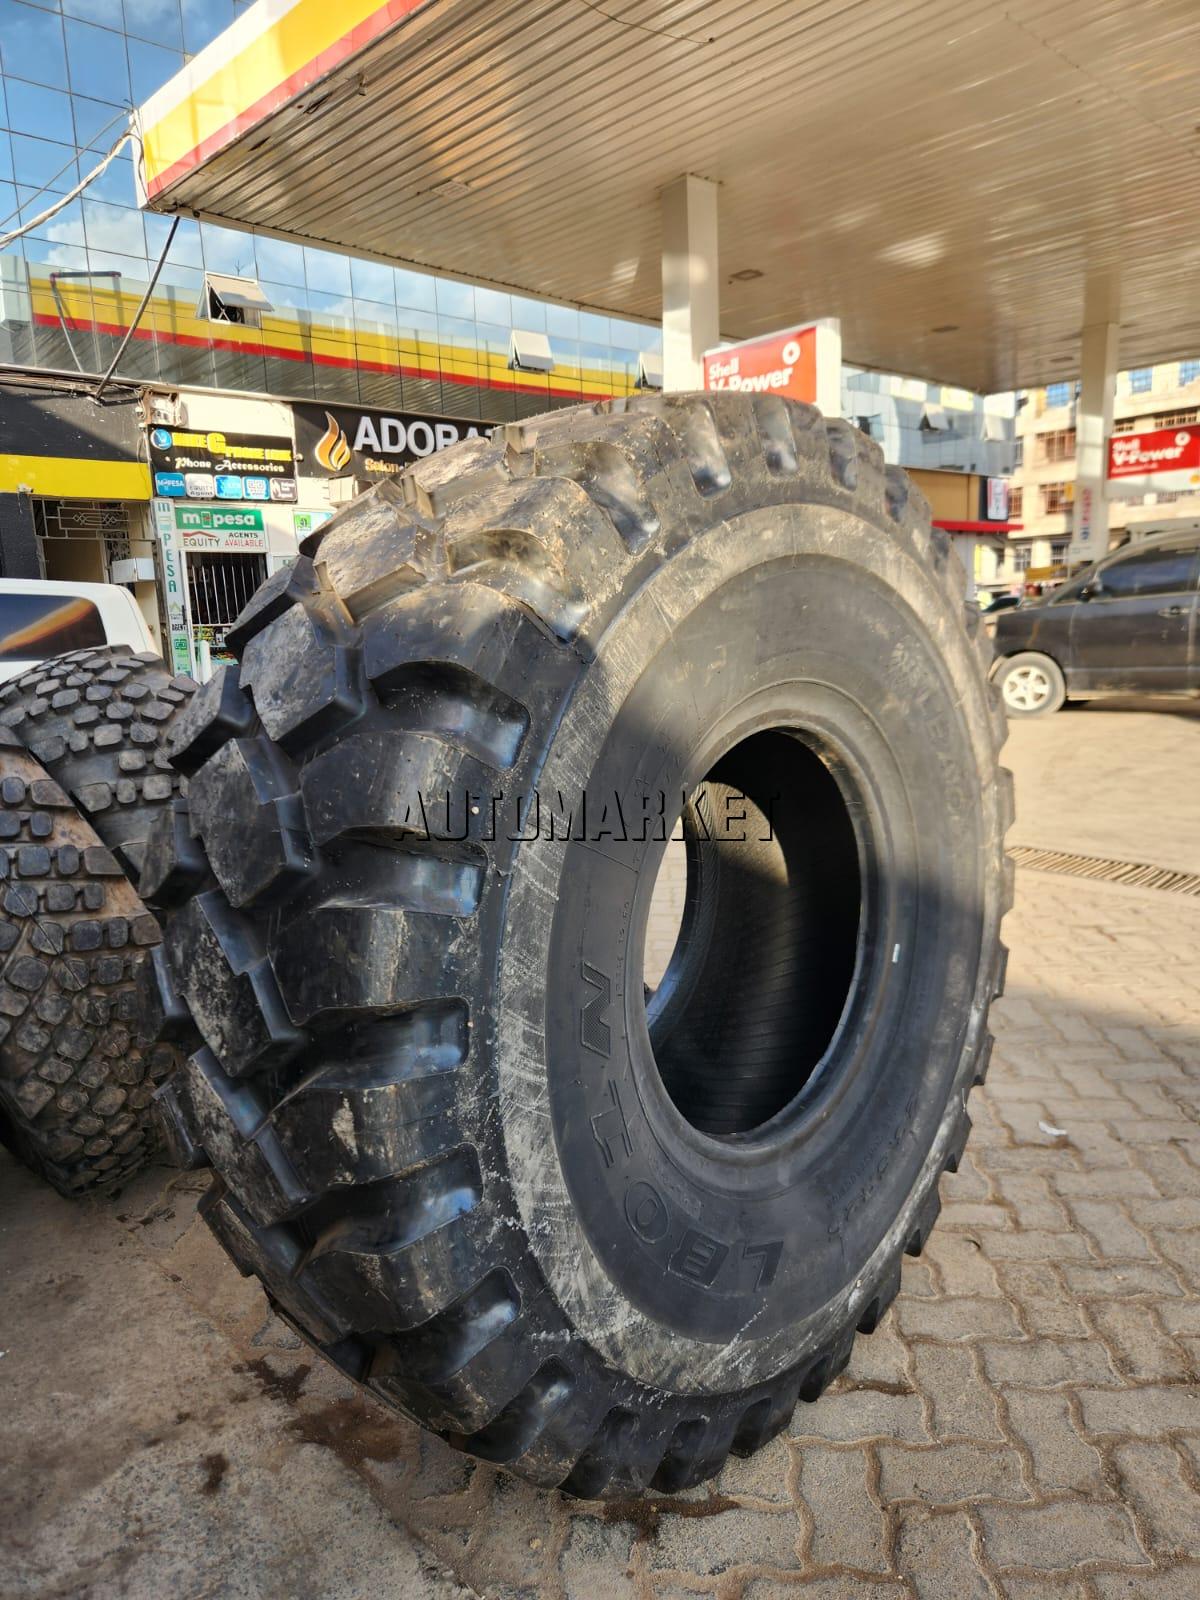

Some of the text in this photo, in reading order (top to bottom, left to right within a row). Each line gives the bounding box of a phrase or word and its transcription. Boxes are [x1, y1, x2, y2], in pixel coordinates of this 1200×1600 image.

[709, 357, 739, 380] Shell
[709, 367, 793, 392] V-Power
[353, 416, 494, 458] ADOR
[174, 457, 285, 473] Phone Accessories
[183, 537, 221, 547] EQUITY
[224, 539, 264, 547] AVAILABLE
